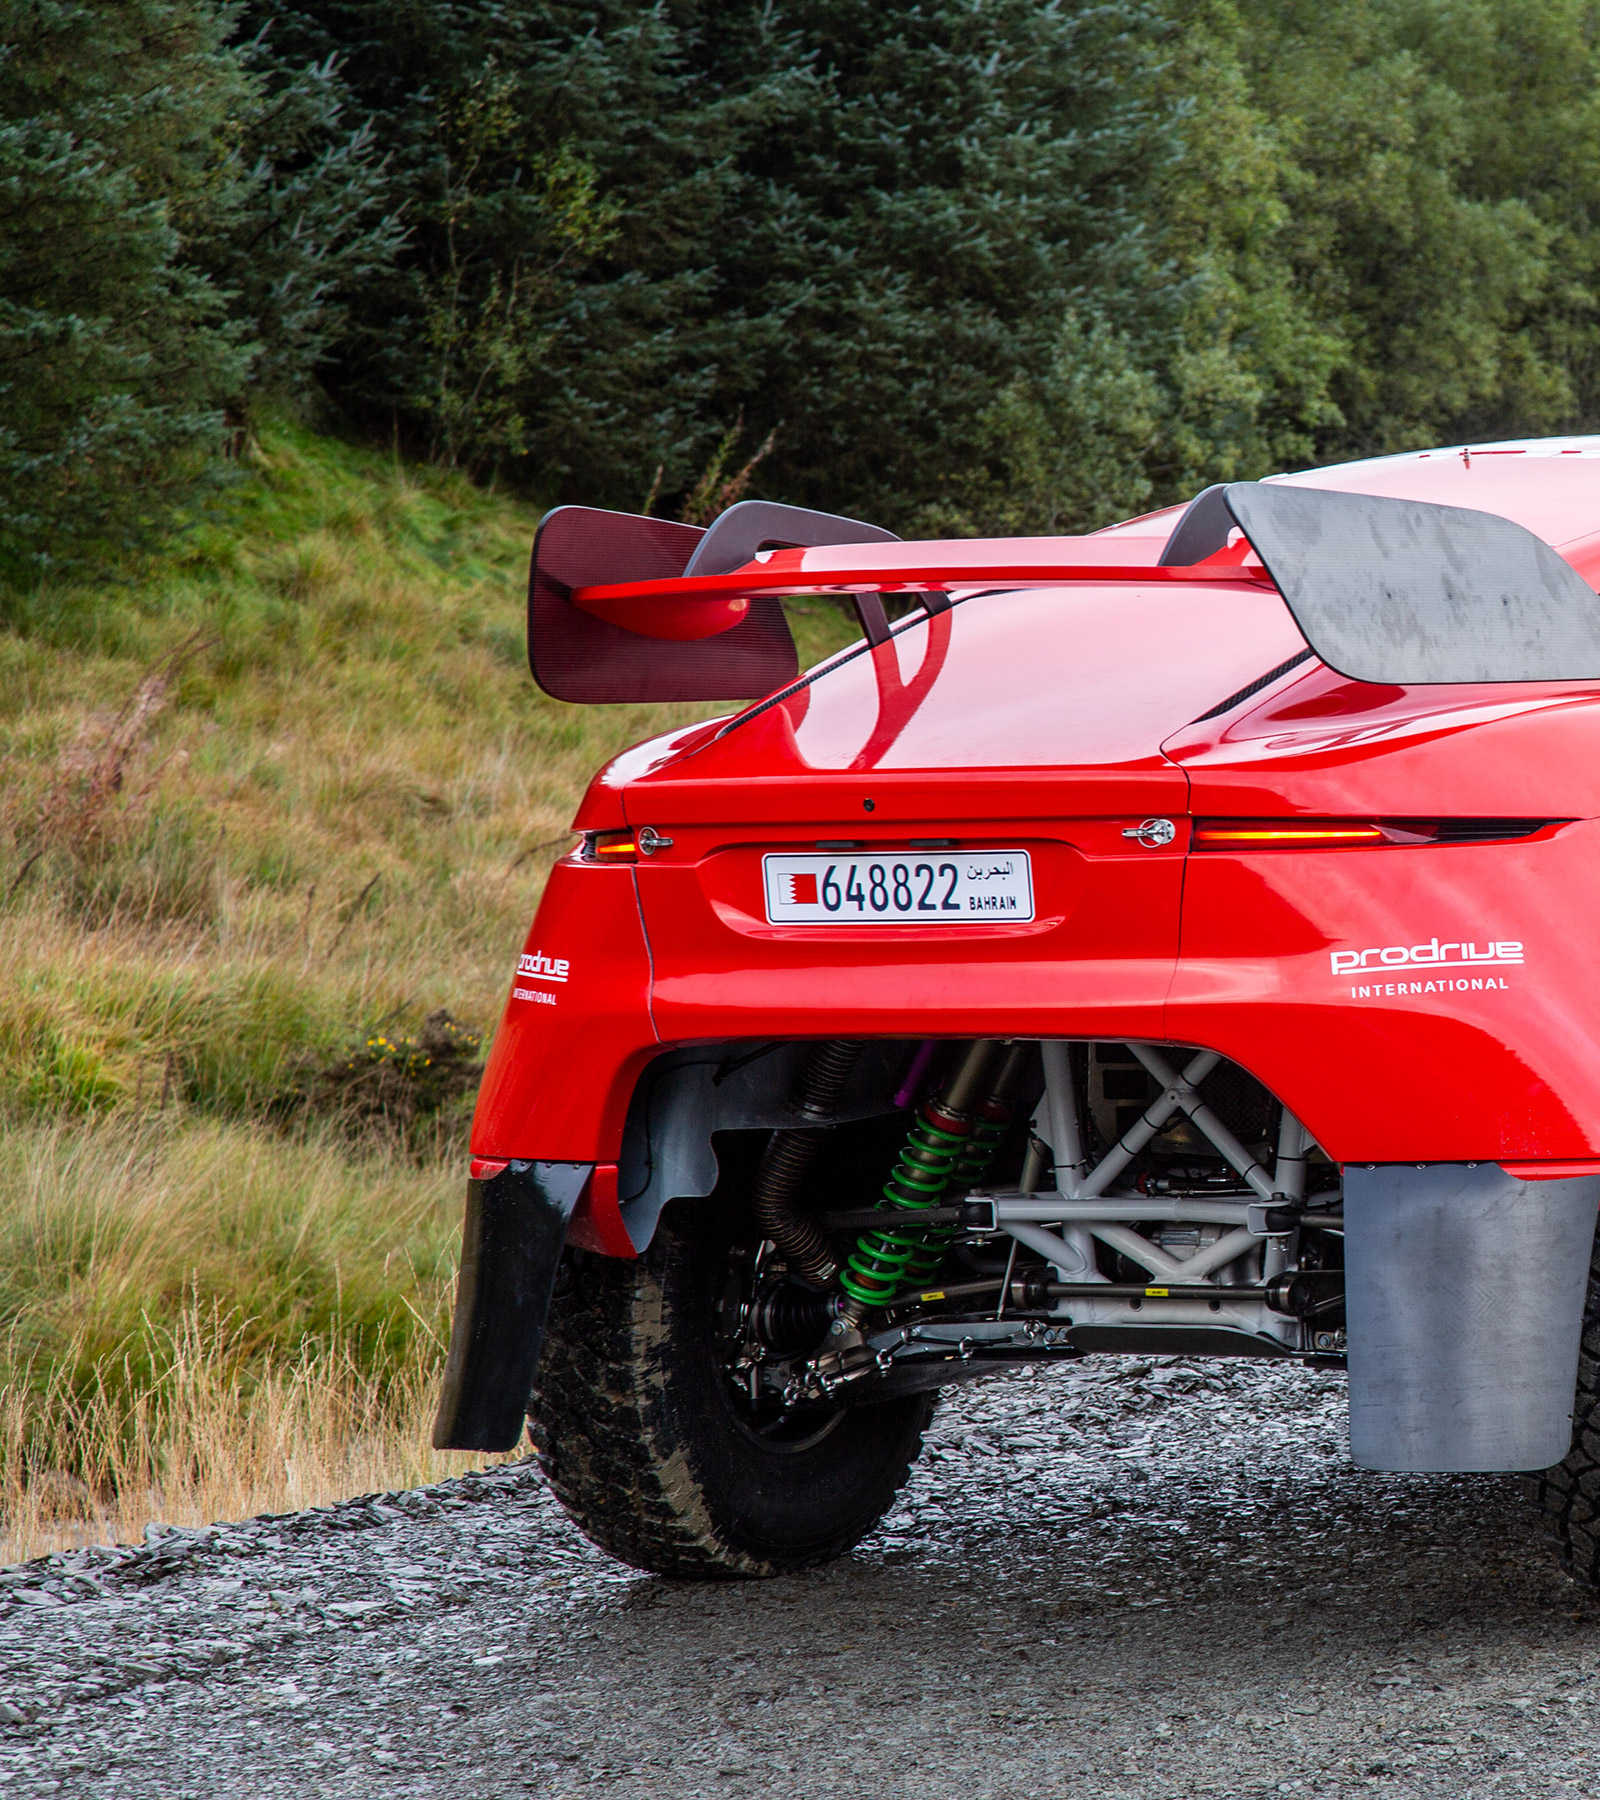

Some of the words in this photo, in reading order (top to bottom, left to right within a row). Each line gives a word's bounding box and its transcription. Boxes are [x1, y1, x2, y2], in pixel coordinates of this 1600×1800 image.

[966, 861, 1014, 880] البحرين
[821, 863, 961, 912] 648822
[969, 896, 1017, 911] BAHRAIN
[1330, 937, 1525, 976] prodrive
[1351, 977, 1509, 999] INTERNATIONAL
